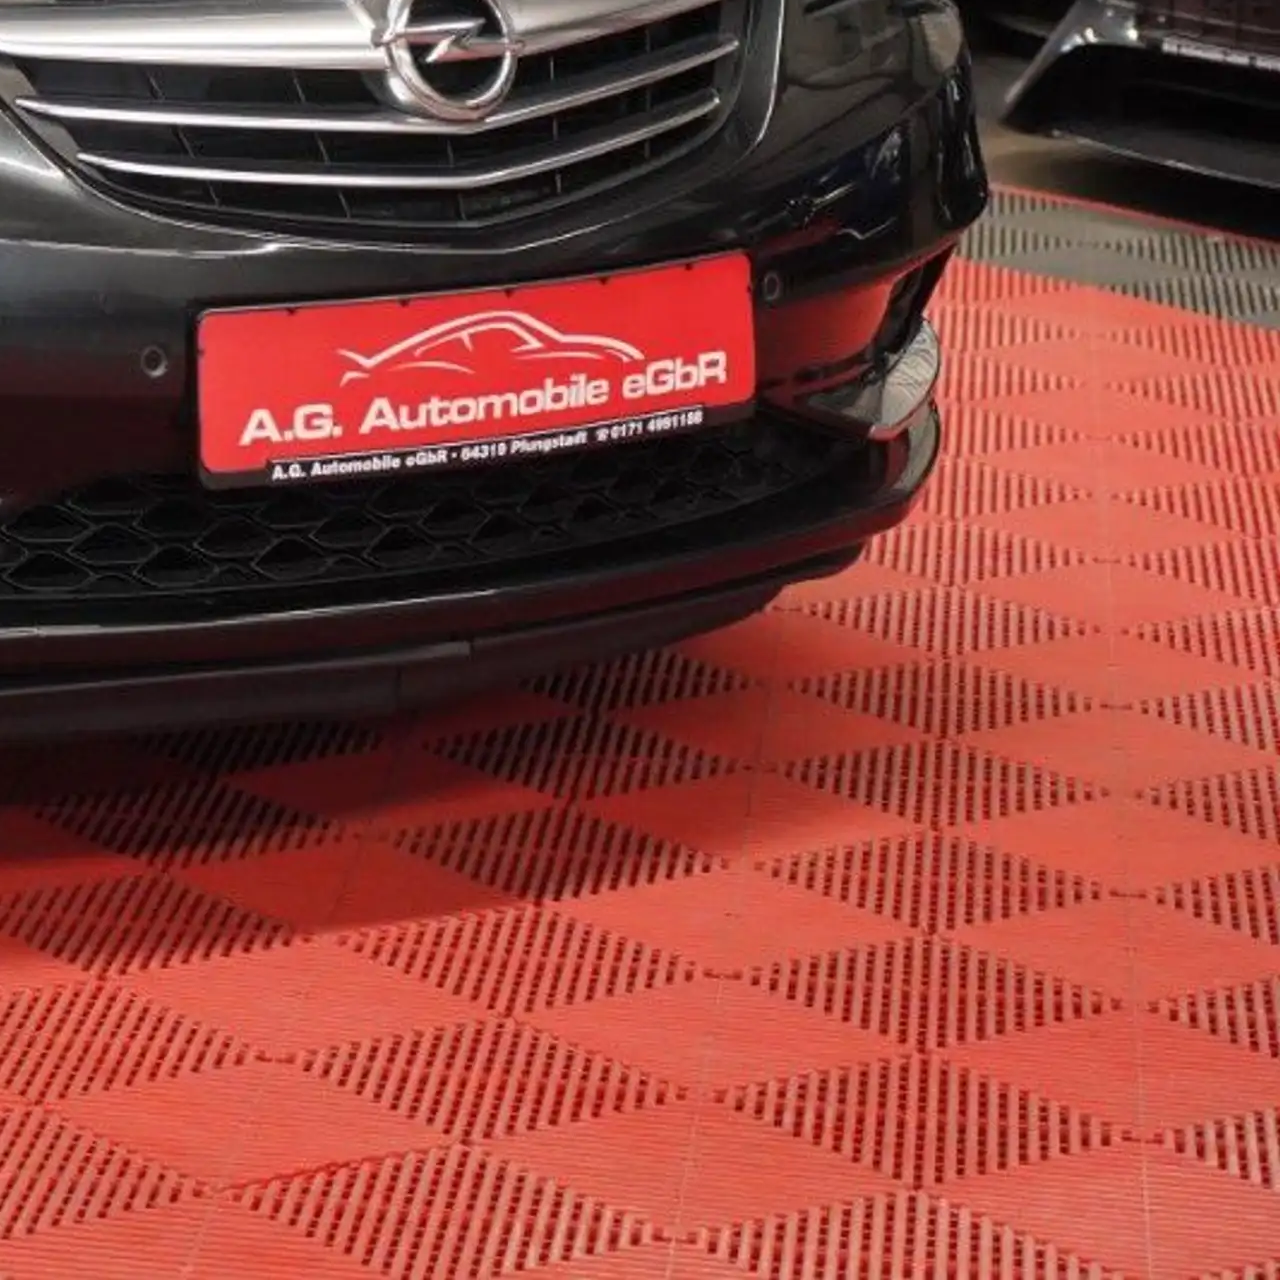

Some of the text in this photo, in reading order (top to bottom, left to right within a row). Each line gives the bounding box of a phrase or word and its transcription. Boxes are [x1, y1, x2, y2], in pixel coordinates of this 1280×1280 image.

[239, 350, 728, 446] A.G. Automobile eGbR
[310, 457, 400, 477] Automobile
